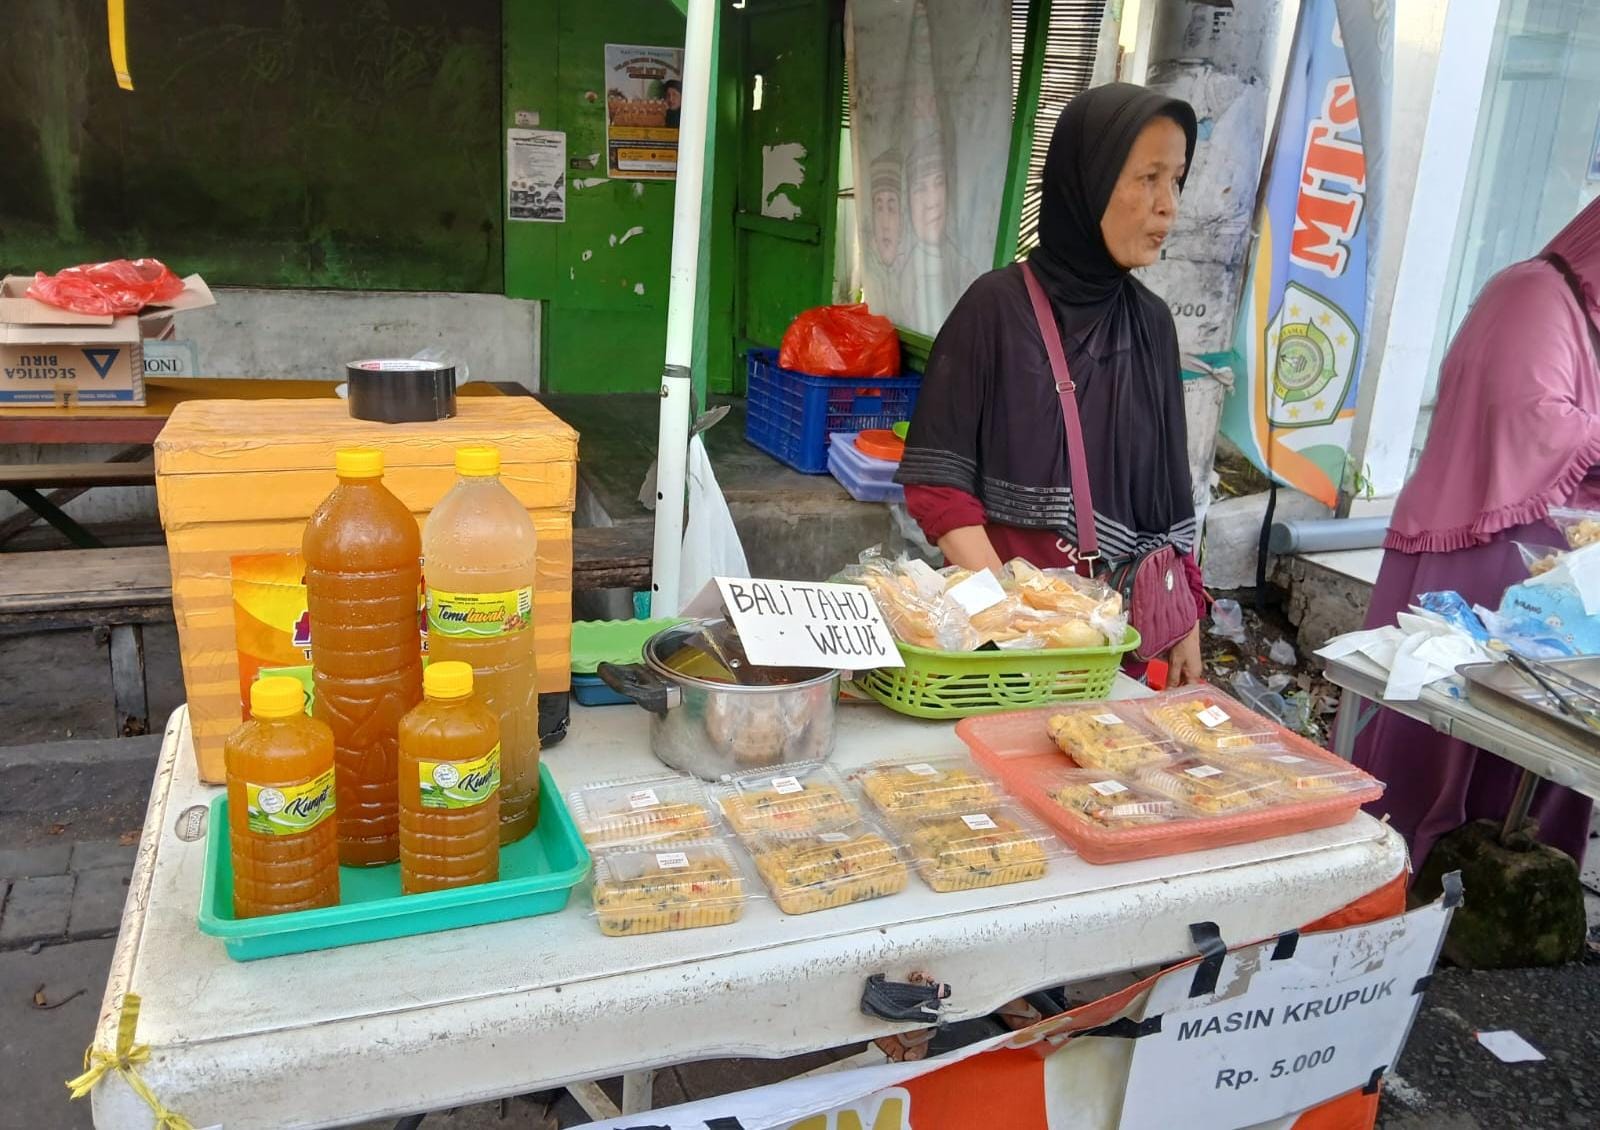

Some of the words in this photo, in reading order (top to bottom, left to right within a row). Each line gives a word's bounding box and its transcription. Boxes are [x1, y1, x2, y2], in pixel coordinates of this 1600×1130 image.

[20, 355, 58, 366] BIRU
[4, 367, 77, 380] SEGITIGA
[438, 603, 506, 624] Temulawak
[1177, 1007, 1275, 1041] MASIN
[1282, 977, 1397, 1024] KRUPUK
[1215, 1068, 1259, 1090] Rp.
[1269, 1045, 1336, 1079] 5.000
